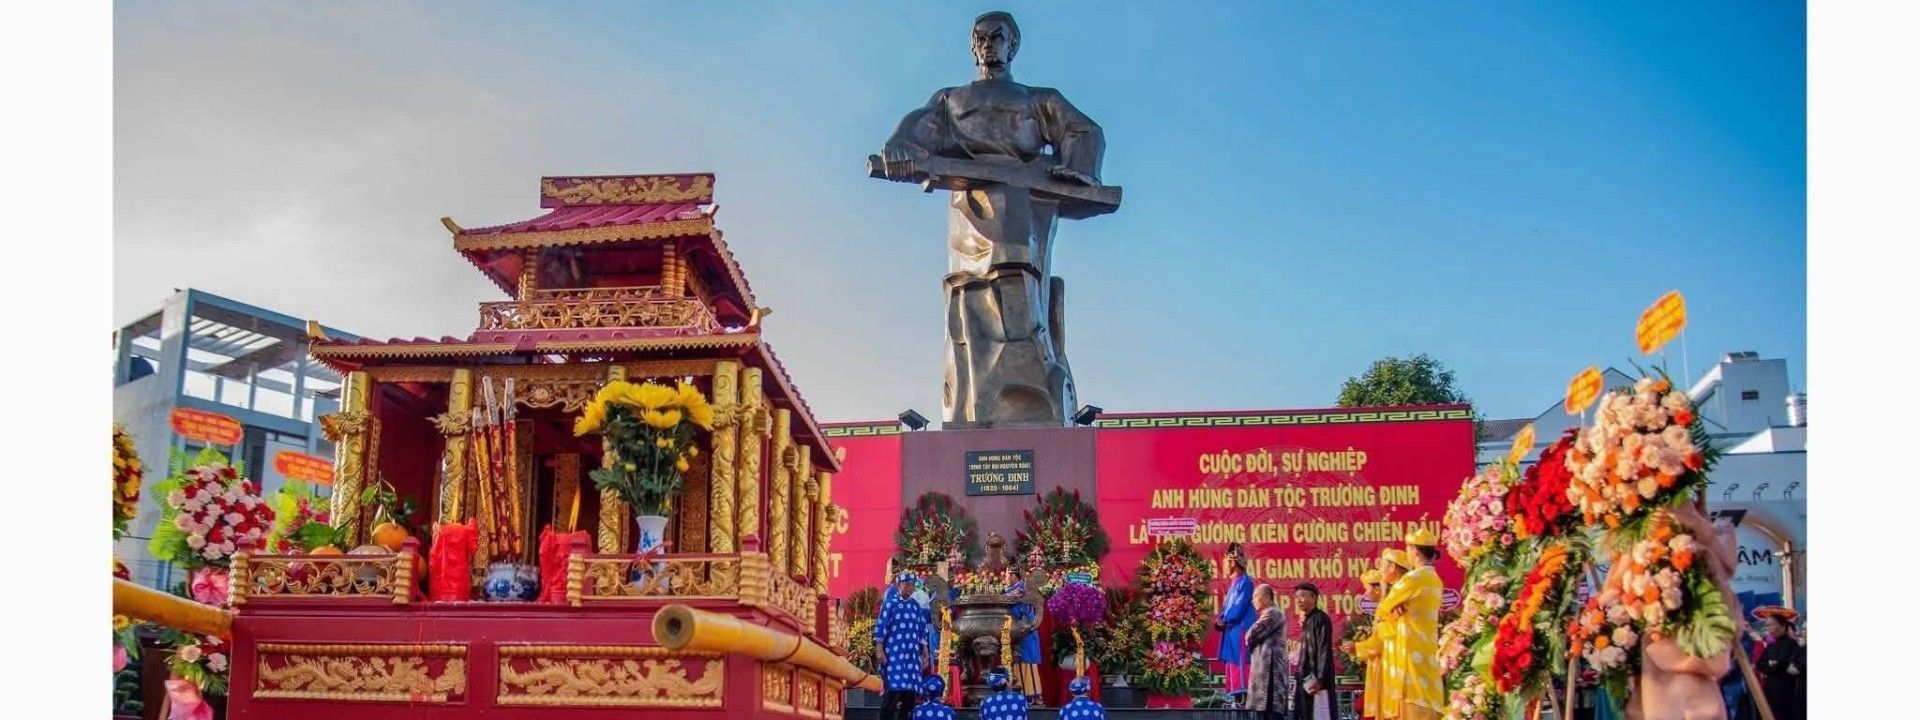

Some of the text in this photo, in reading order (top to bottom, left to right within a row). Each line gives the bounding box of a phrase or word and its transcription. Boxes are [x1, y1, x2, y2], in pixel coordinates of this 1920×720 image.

[1199, 446, 1367, 479] CUỘC ĐỜI, SỰ NGHIỆP
[1151, 482, 1420, 514] ANH HÙNG DÂN TỘC TRƯƠNG ĐỊNH
[1129, 519, 1149, 544] LÀ
[1250, 519, 1289, 543] KIÊN
[1292, 516, 1349, 544] CƯỜNG
[1352, 512, 1403, 542] CHIẾN
[1265, 558, 1305, 579] GIAN
[1309, 548, 1343, 579] KHỔ
